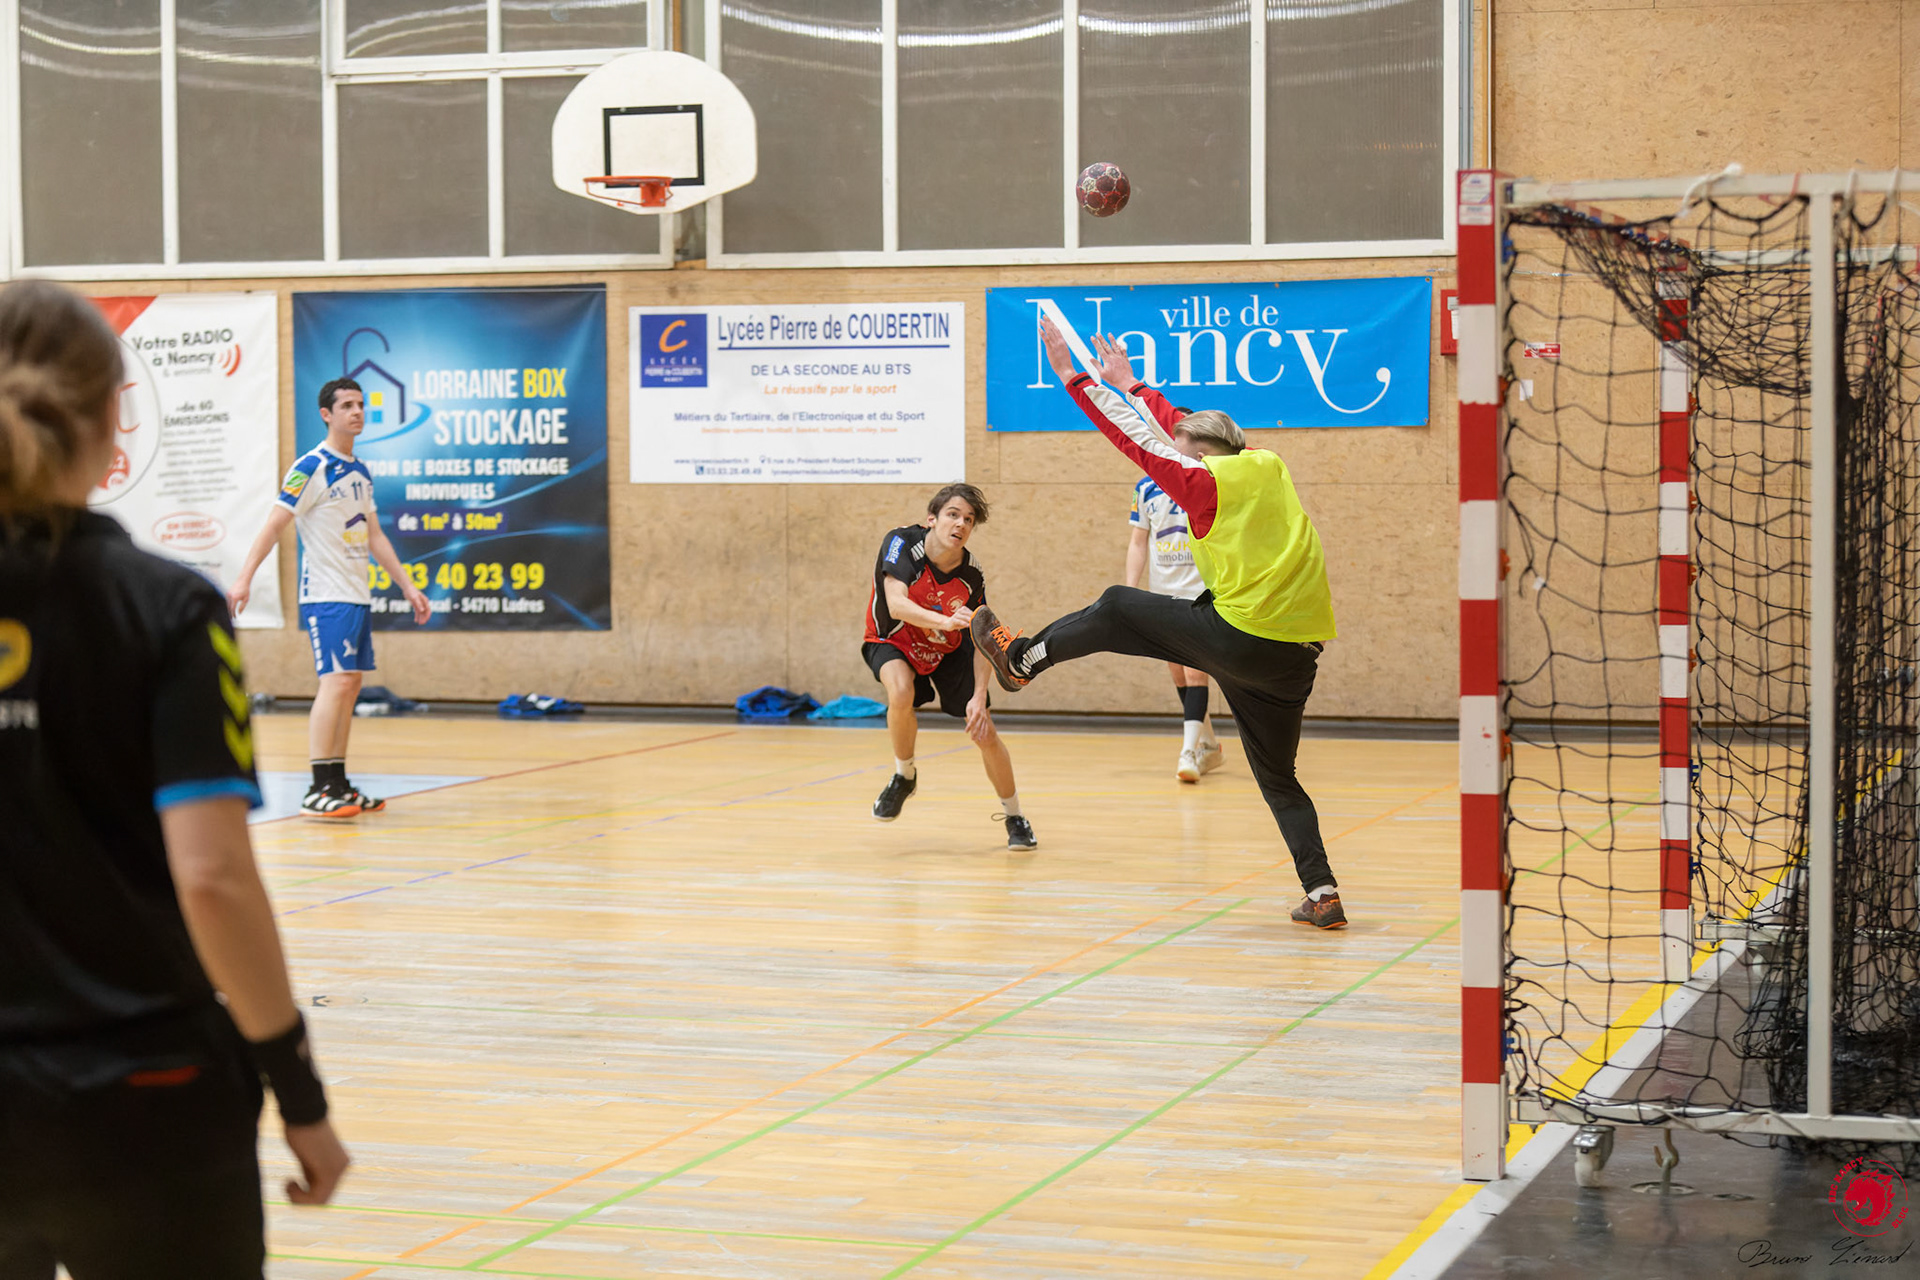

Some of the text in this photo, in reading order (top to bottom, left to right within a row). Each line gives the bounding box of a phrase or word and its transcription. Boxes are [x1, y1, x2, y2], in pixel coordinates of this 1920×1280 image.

[1159, 295, 1279, 328] ville de
[132, 328, 233, 350] Votre RADIO
[659, 320, 688, 353] C
[717, 312, 950, 348] Lycée Pierre de COUBERTIN
[152, 352, 215, 366] à Nancy
[1026, 297, 1391, 413] Nancy
[751, 363, 912, 376] DE LA SECONDE AU BTS
[413, 368, 567, 399] LORRAINE BOX
[764, 383, 897, 397] La réussite par le sport
[674, 412, 711, 421] Métiers
[713, 412, 727, 421] du
[730, 412, 774, 422] Tertiaire,
[777, 412, 790, 421] de
[866, 412, 877, 421] et
[880, 412, 893, 421] du
[896, 411, 925, 422] Sport
[434, 408, 569, 446] STOCKAGE
[402, 459, 423, 476] DE
[424, 458, 472, 476] BOXES
[474, 458, 495, 476] DE
[497, 457, 569, 476] STOCKAGE
[351, 481, 363, 501] 11
[405, 482, 495, 501] INDIVIDUELS
[398, 512, 503, 531] de 1m² à 50m²
[435, 562, 467, 590] 40
[473, 562, 504, 590] 23
[510, 562, 545, 590] 99
[389, 599, 411, 613] rue
[461, 597, 498, 613] 54710
[502, 597, 545, 613] Ludres
